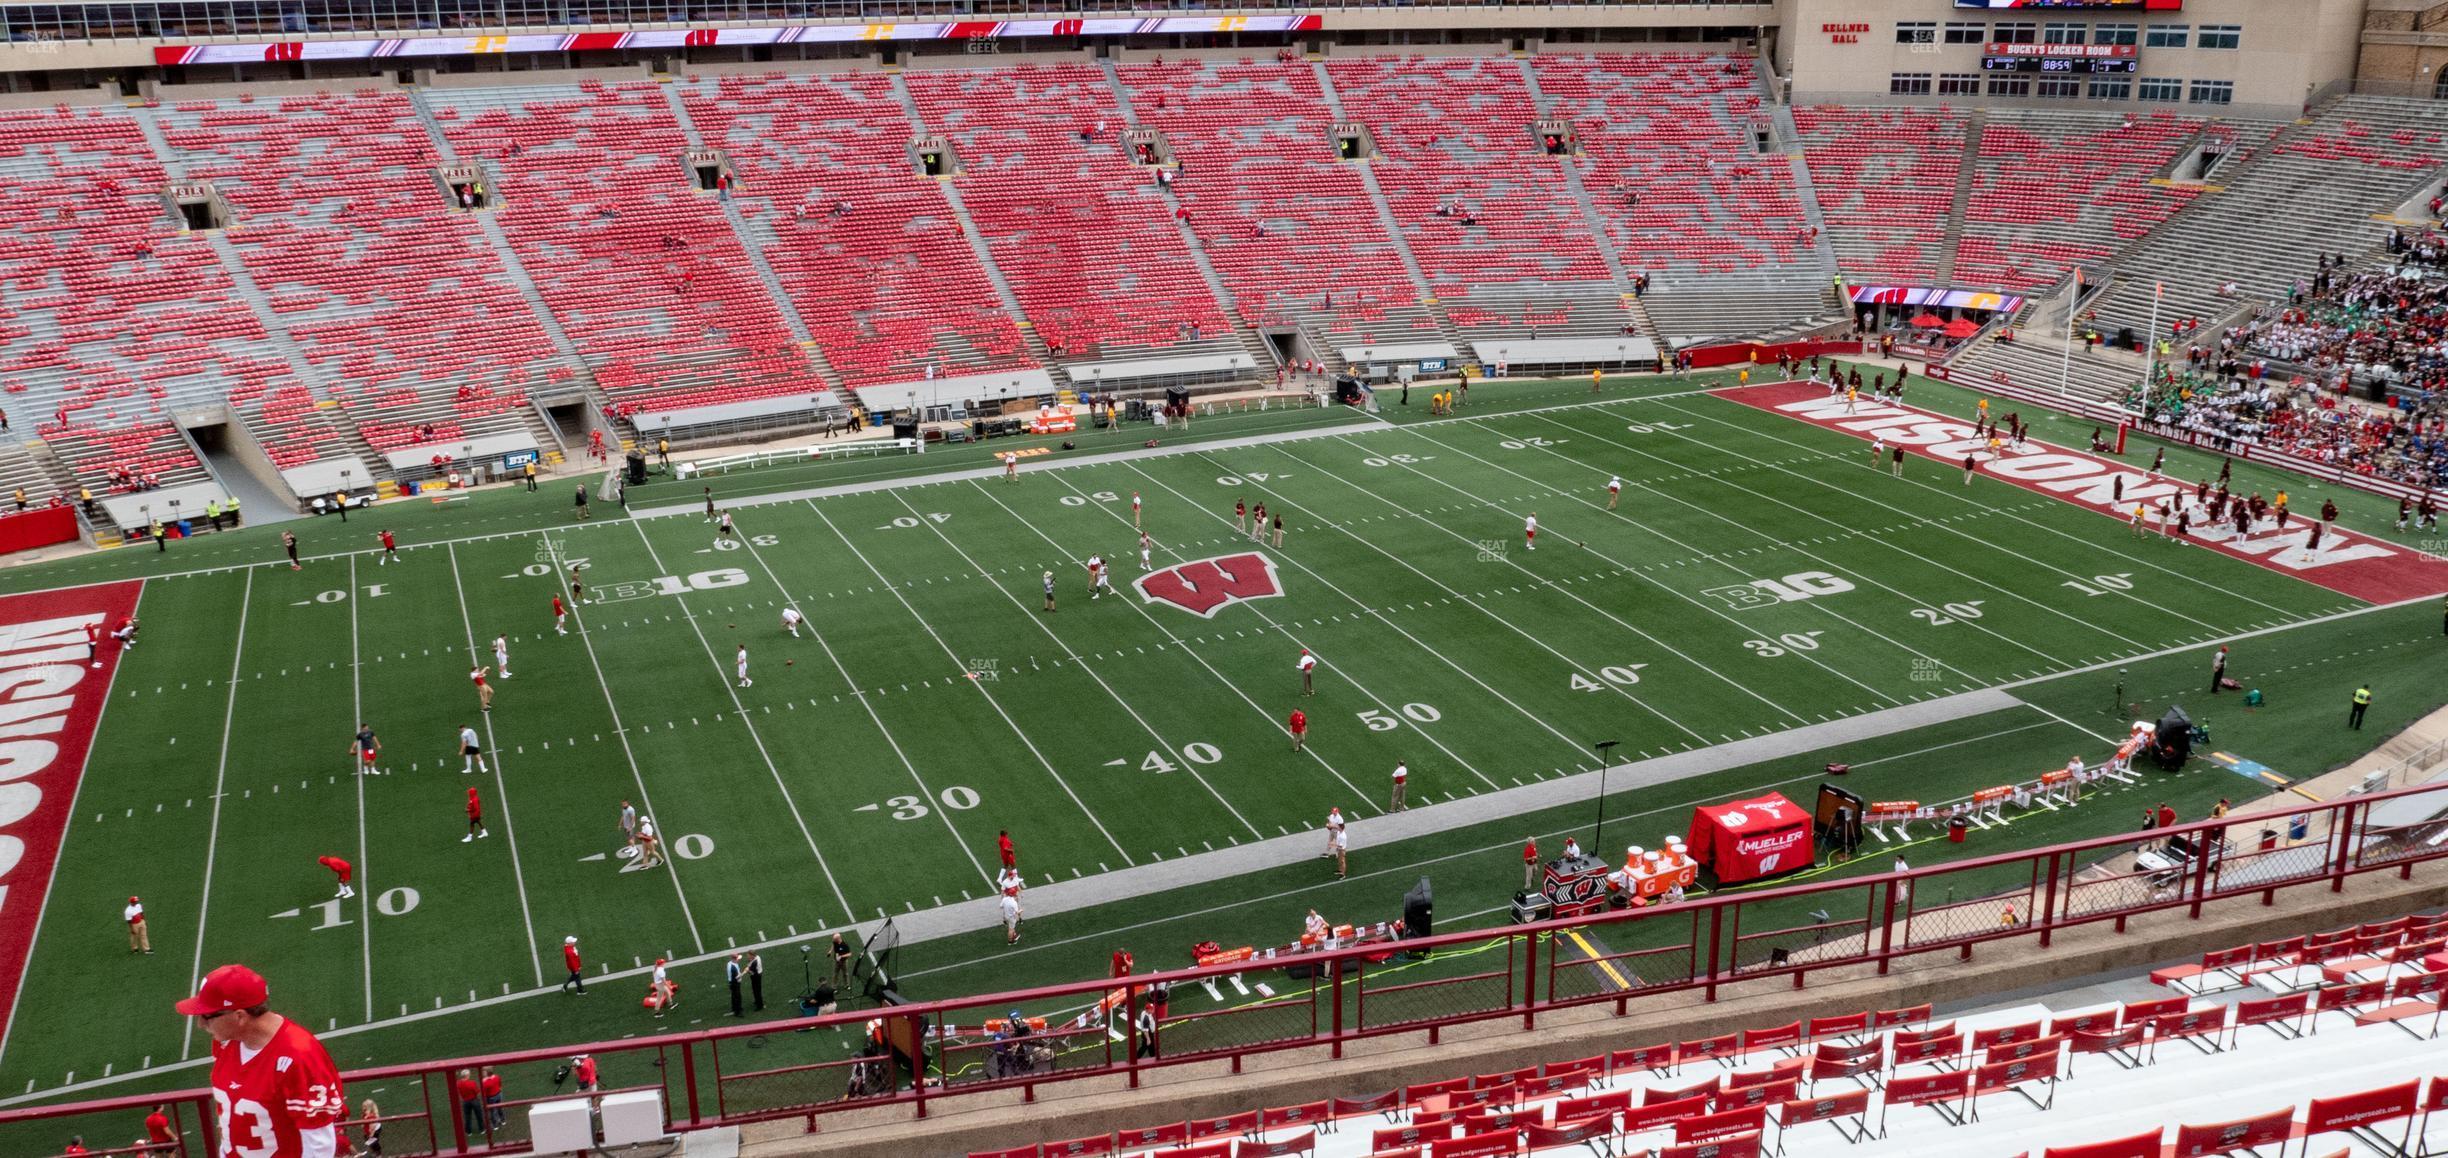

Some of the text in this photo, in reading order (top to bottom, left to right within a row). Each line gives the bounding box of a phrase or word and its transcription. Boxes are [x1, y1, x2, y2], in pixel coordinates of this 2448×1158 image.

[1822, 23, 1870, 33] KELLNER
[1832, 34, 1858, 44] HALL
[2007, 44, 2113, 56] BUCKY'S LOCKER ROOM
[1986, 59, 1993, 69] 0
[2043, 60, 2070, 70] 88:59
[2128, 62, 2136, 72] 0
[1498, 436, 1554, 450] 20
[2194, 433, 2245, 456] BARS
[1362, 453, 1420, 468] 30
[1215, 470, 1271, 487] 40
[1778, 396, 2399, 570] WISCONSIN
[1060, 490, 1121, 507] 50
[893, 511, 952, 529] 40
[713, 533, 780, 552] 30
[315, 582, 392, 603] 10
[1131, 551, 1286, 620] W
[2062, 574, 2135, 597] 10
[1910, 601, 1985, 627] 20
[1742, 631, 1821, 658] 30
[1569, 665, 1643, 693] 40
[1356, 702, 1442, 731] 50
[1141, 742, 1223, 774] 40
[886, 786, 982, 822] 30
[1745, 830, 1804, 851] MUELLER
[1678, 869, 1691, 883] G
[1644, 879, 1656, 893] G
[308, 886, 422, 931] 10
